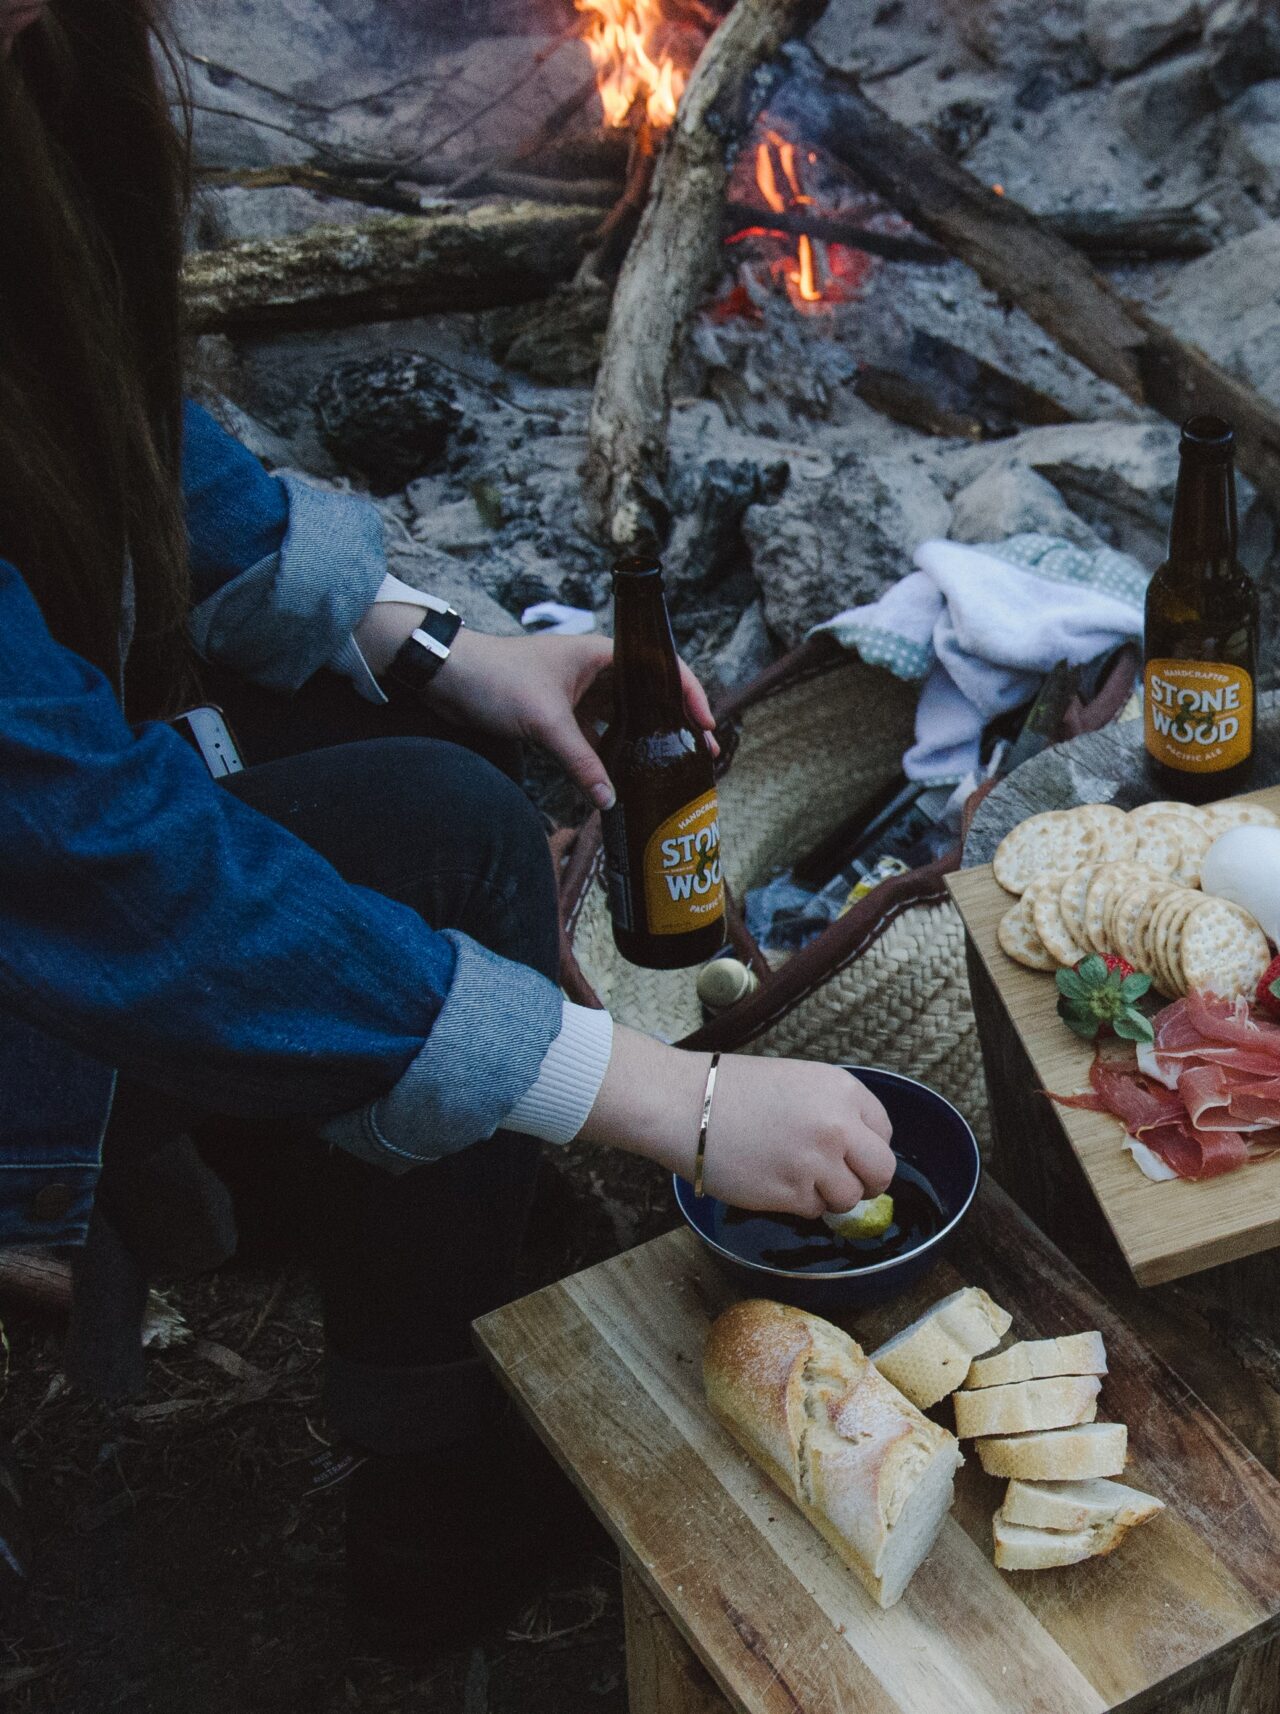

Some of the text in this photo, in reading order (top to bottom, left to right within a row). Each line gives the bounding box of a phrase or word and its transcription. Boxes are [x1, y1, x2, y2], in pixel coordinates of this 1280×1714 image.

[1163, 670, 1229, 682] HANDCRAFTED
[1151, 674, 1240, 712] STONE
[1152, 703, 1239, 745] WOOD
[1166, 744, 1223, 761] PACIFIC ALE
